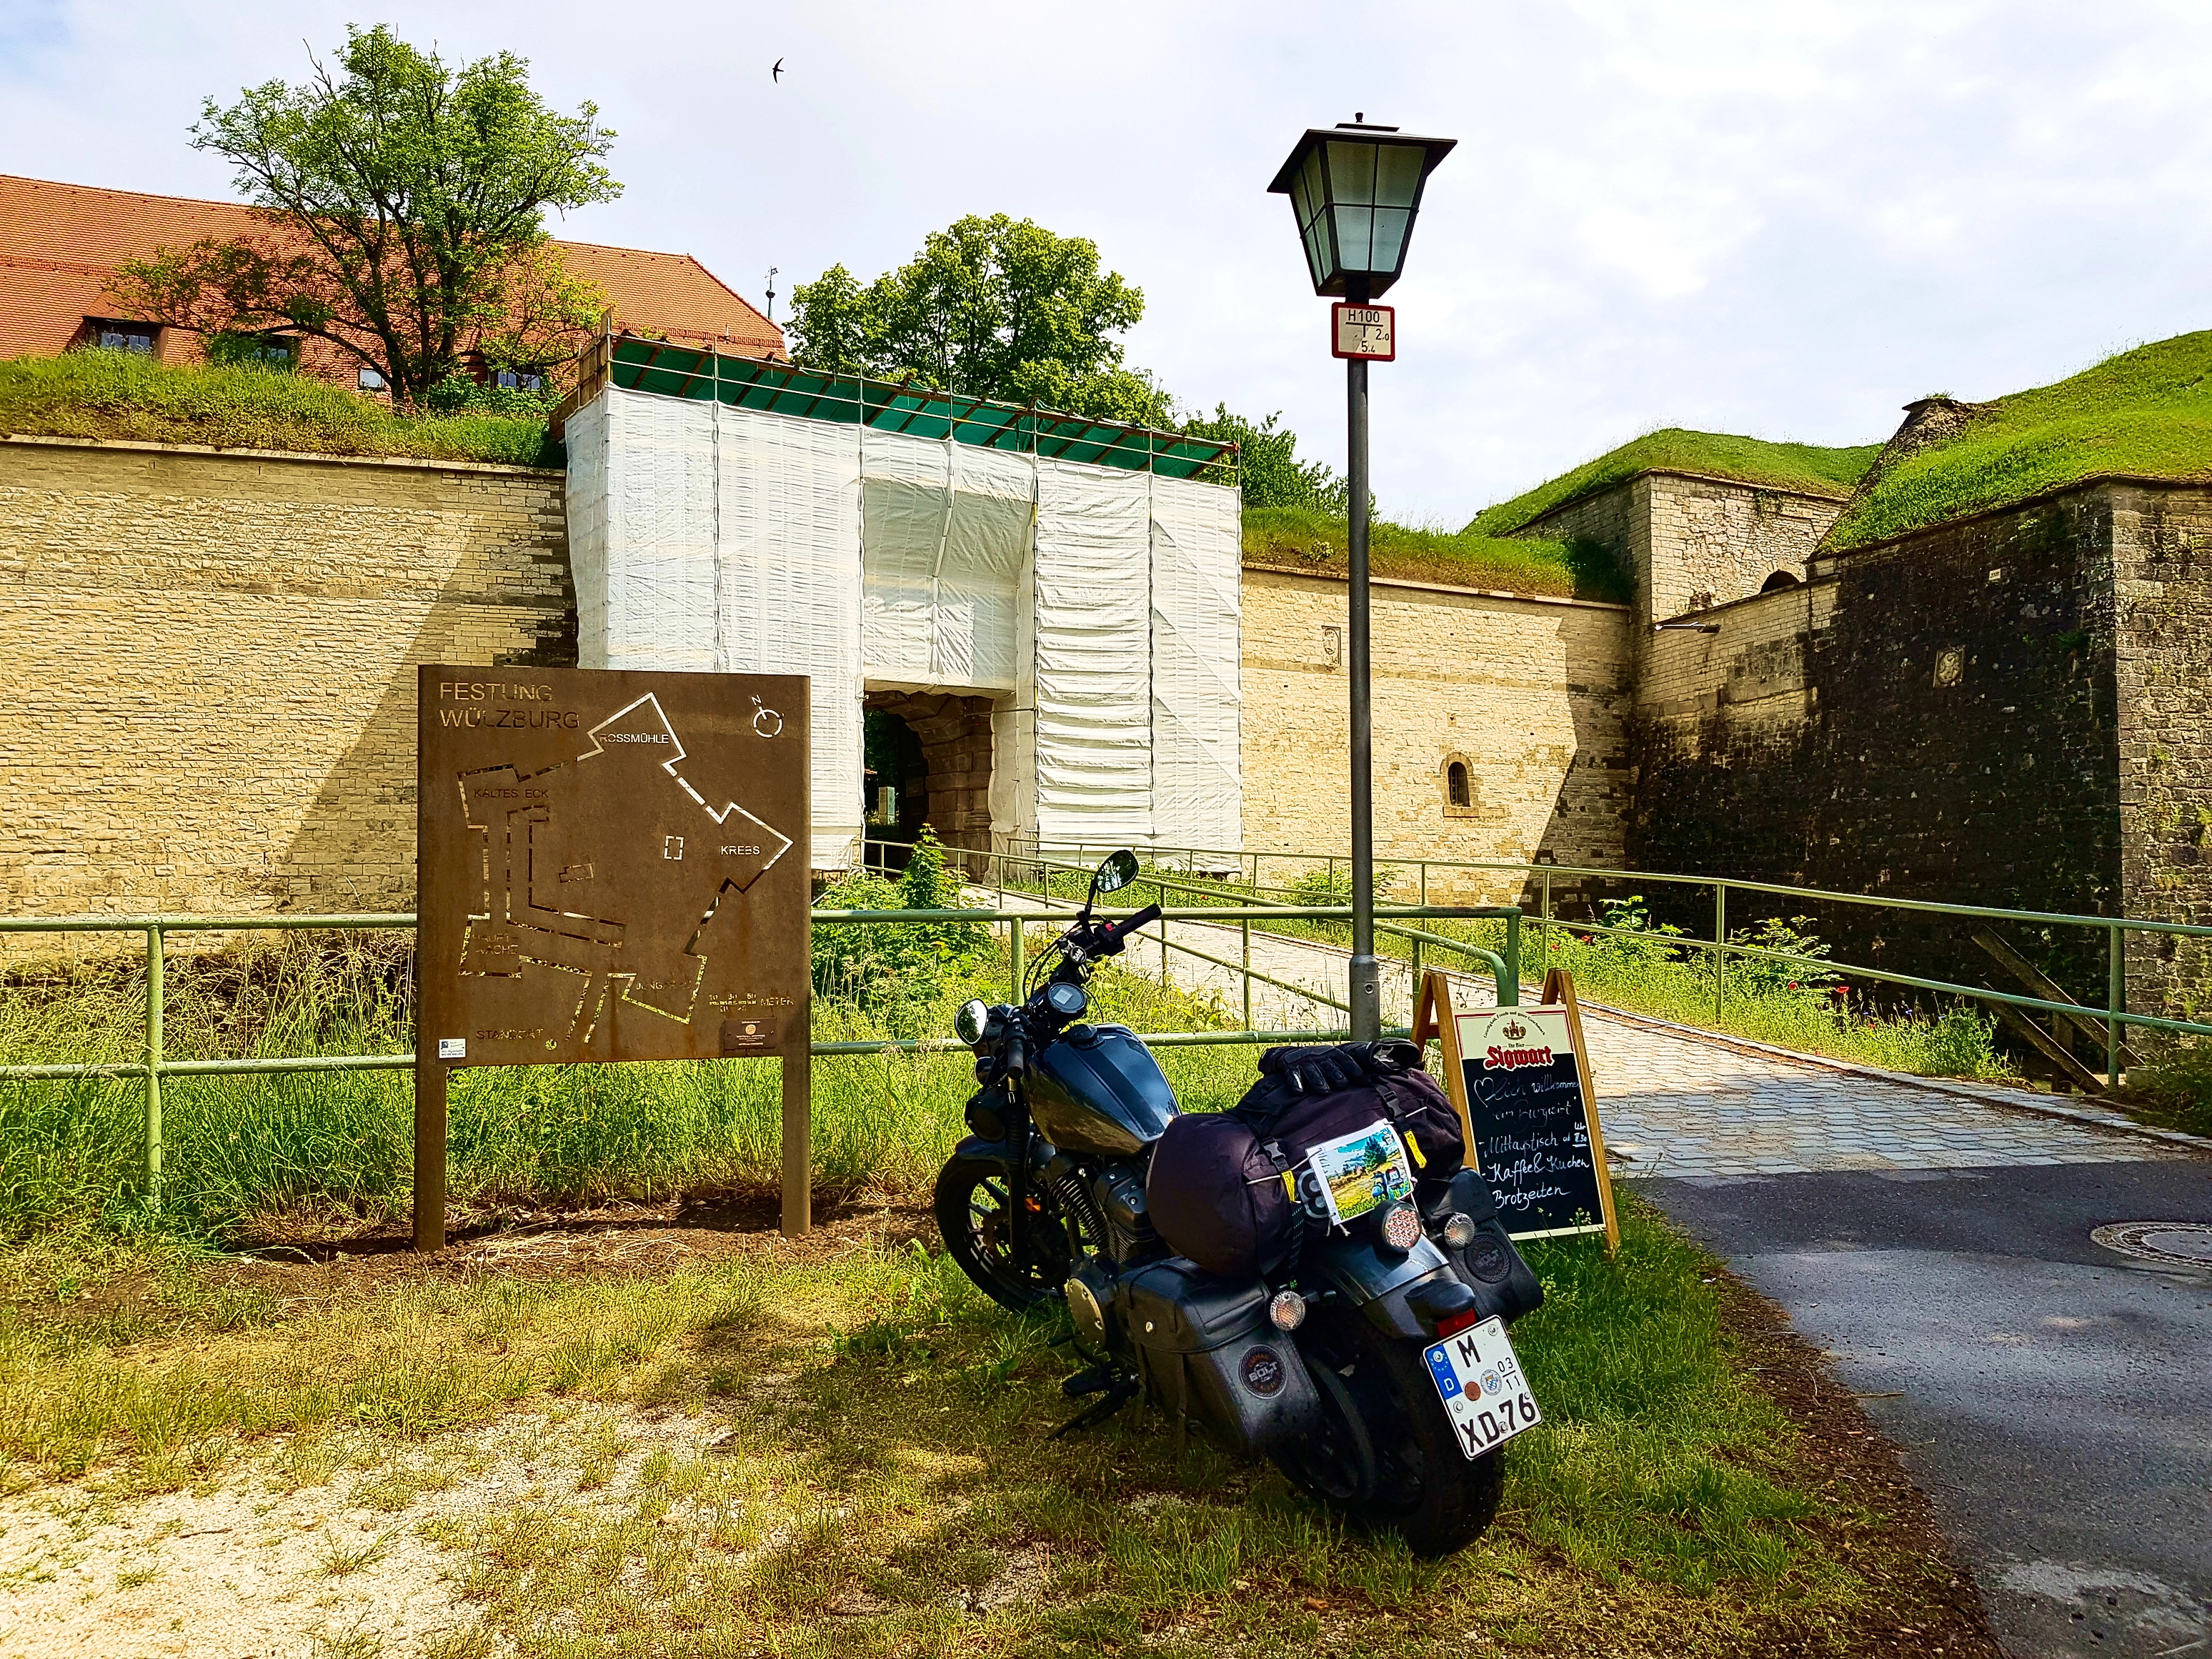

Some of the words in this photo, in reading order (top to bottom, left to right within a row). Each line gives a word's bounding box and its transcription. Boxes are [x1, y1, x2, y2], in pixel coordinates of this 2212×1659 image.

[1375, 328, 1390, 341] 2.0
[439, 682, 553, 702] FESTUNG
[751, 694, 762, 706] N
[439, 707, 580, 729] WÜLZBURG
[599, 732, 670, 744] ROSSMÜHLE
[474, 788, 519, 799] KALTES
[524, 788, 549, 799] ECK
[720, 845, 761, 855] KREBS
[1485, 1045, 1553, 1070] Sigwart
[1545, 1155, 1590, 1173] Kuchen
[1493, 1181, 1572, 1211] Brotzeiten
[1456, 1335, 1481, 1368] M
[1497, 1357, 1513, 1372] 03
[1444, 1377, 1455, 1392] D
[1505, 1375, 1520, 1390] 11
